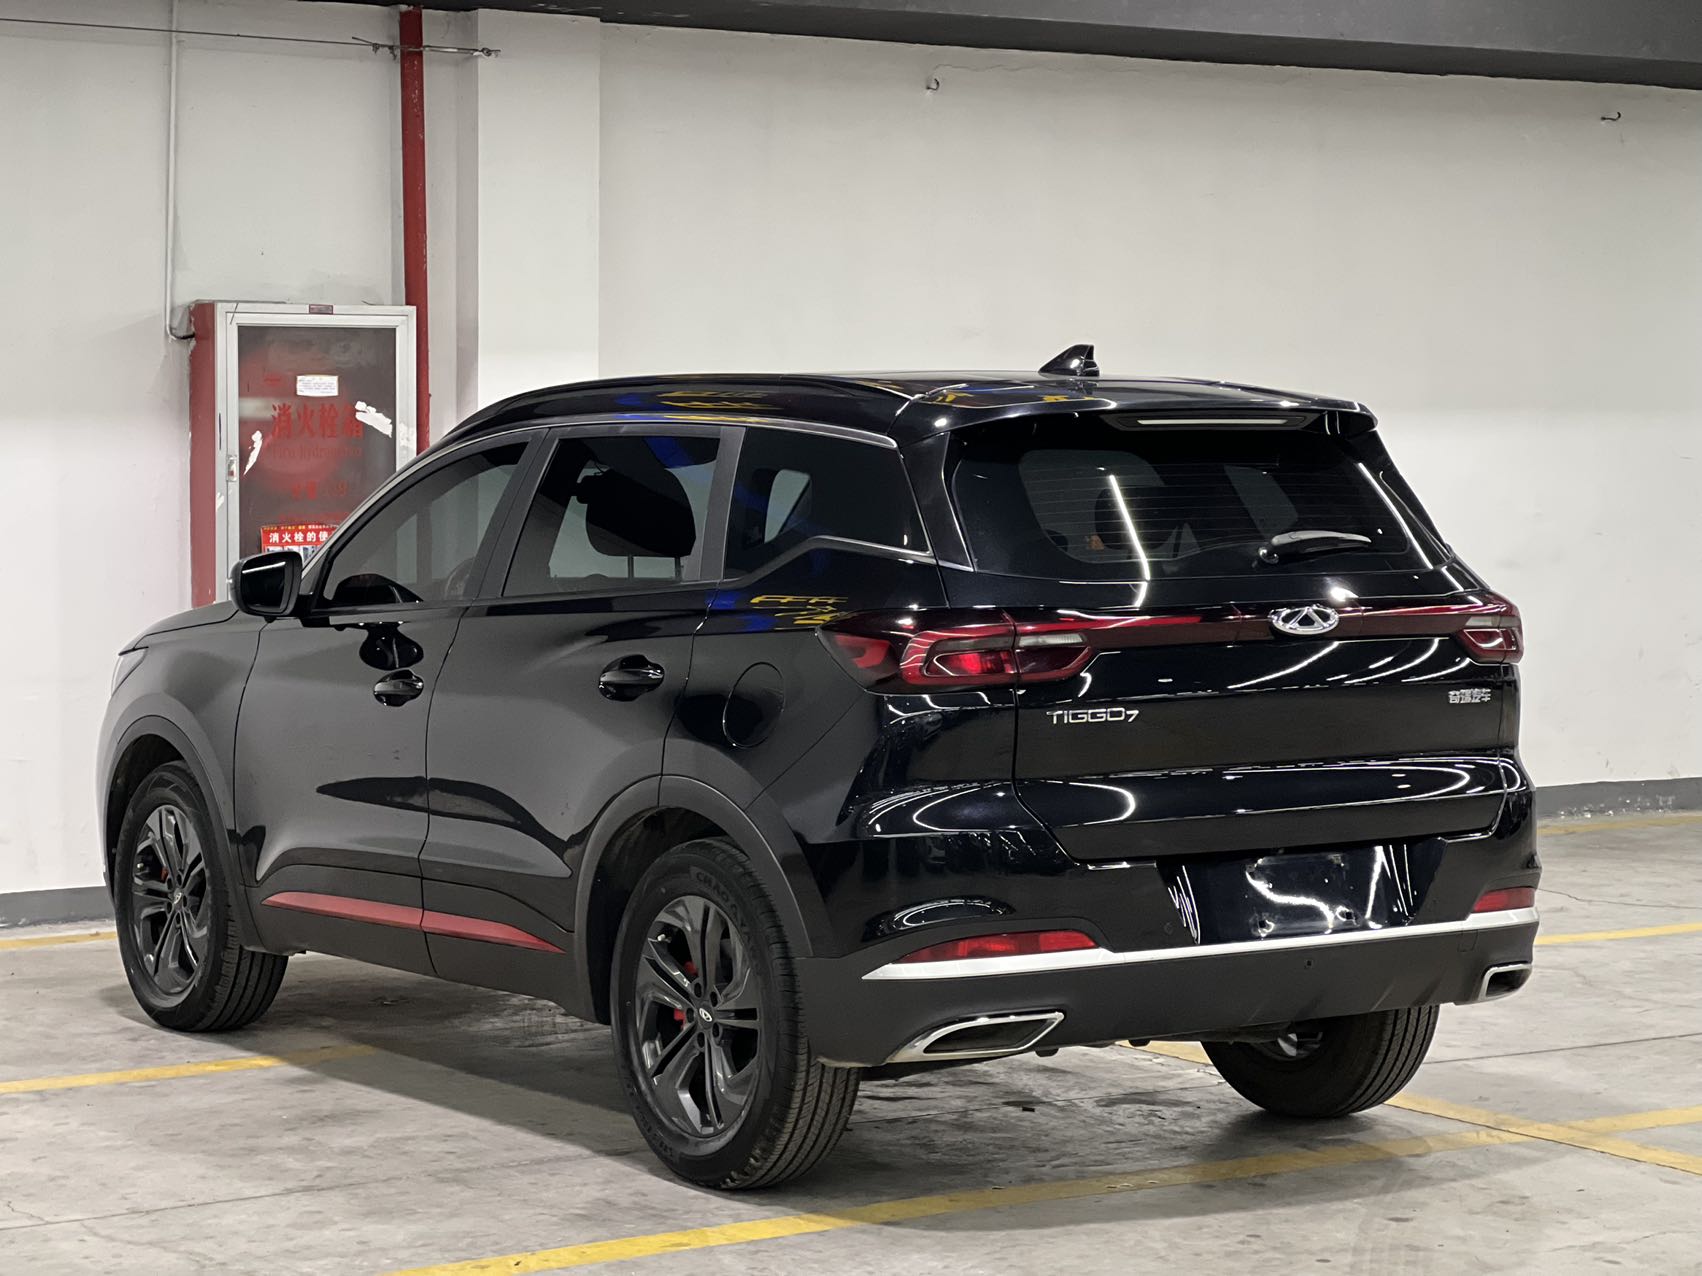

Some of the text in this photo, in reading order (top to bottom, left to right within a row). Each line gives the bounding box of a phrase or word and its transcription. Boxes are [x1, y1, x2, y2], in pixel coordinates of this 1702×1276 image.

[269, 531, 335, 543] 消火栓的使
